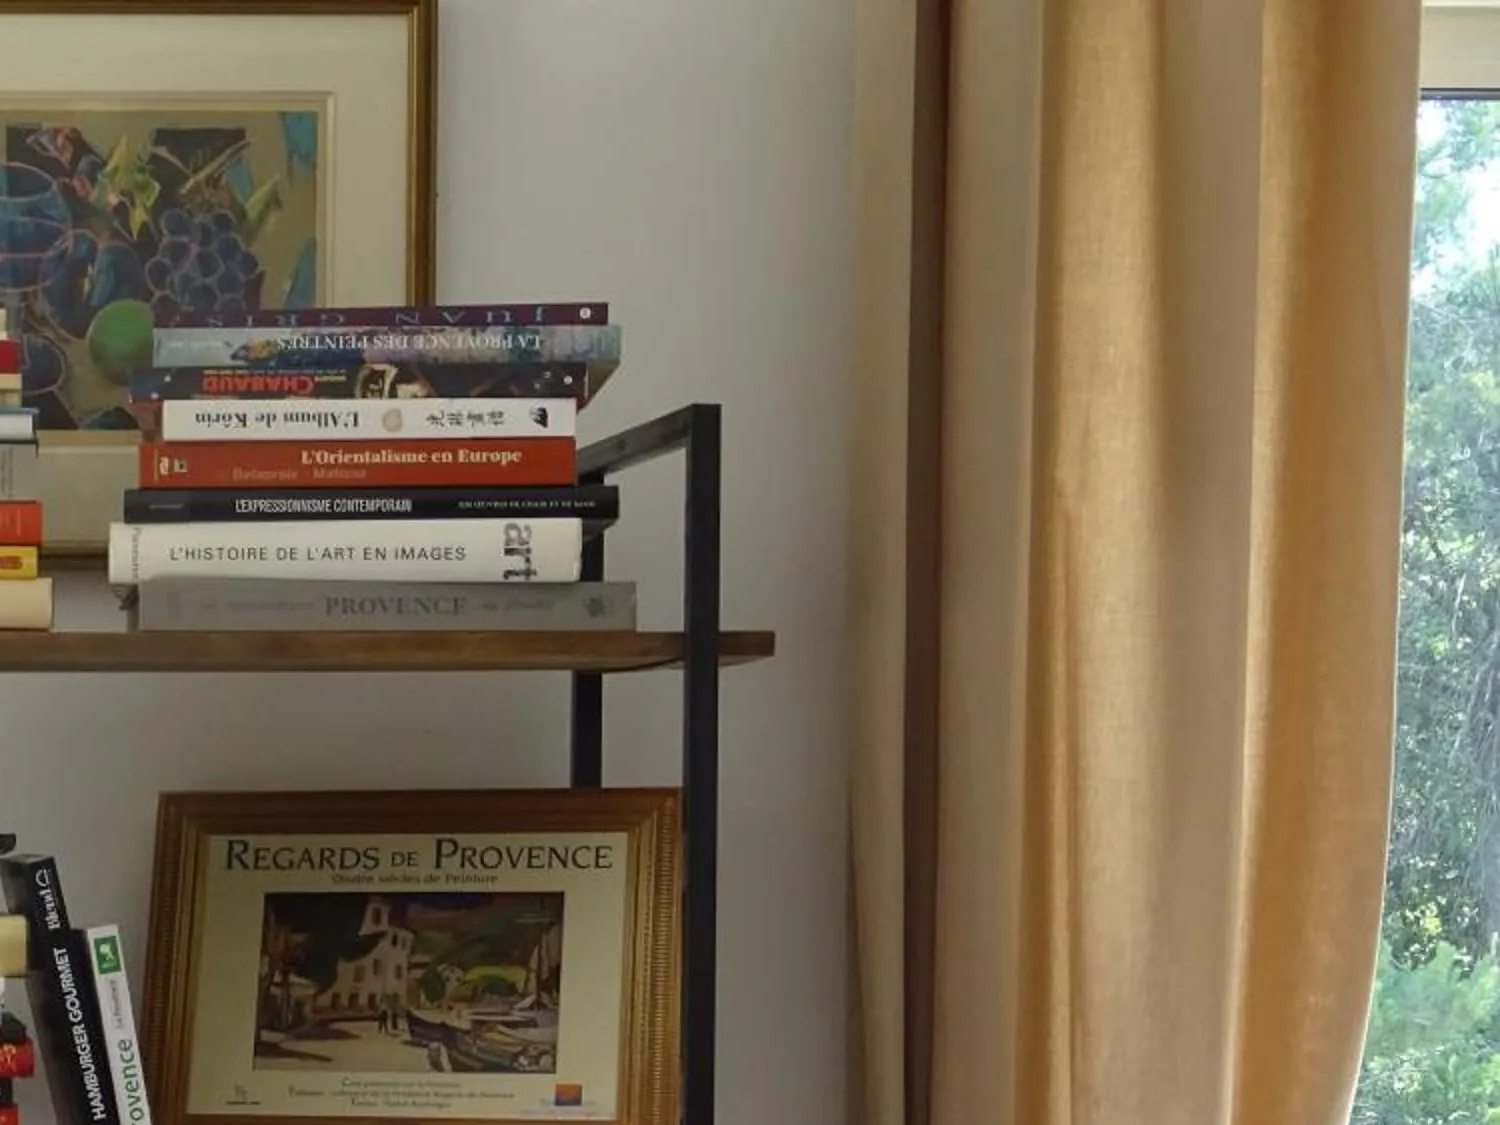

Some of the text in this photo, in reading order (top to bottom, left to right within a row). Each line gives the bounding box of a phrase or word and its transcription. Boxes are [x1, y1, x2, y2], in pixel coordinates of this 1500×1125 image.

[277, 334, 542, 351] LA PROVENCE DES PEINTRES
[203, 371, 315, 395] CHABAUD
[255, 412, 277, 429] de
[283, 411, 360, 429] L'Album
[301, 449, 523, 468] L'Orientalisme en Europe
[169, 546, 468, 562] L'HISTOIRE DE L'ART EN IMAGES
[324, 595, 468, 616] PROVENCE
[331, 873, 375, 885] Quatre
[424, 873, 441, 885] de
[444, 873, 498, 886] Peinture
[52, 947, 107, 1122] HAMBURGER GOURMET
